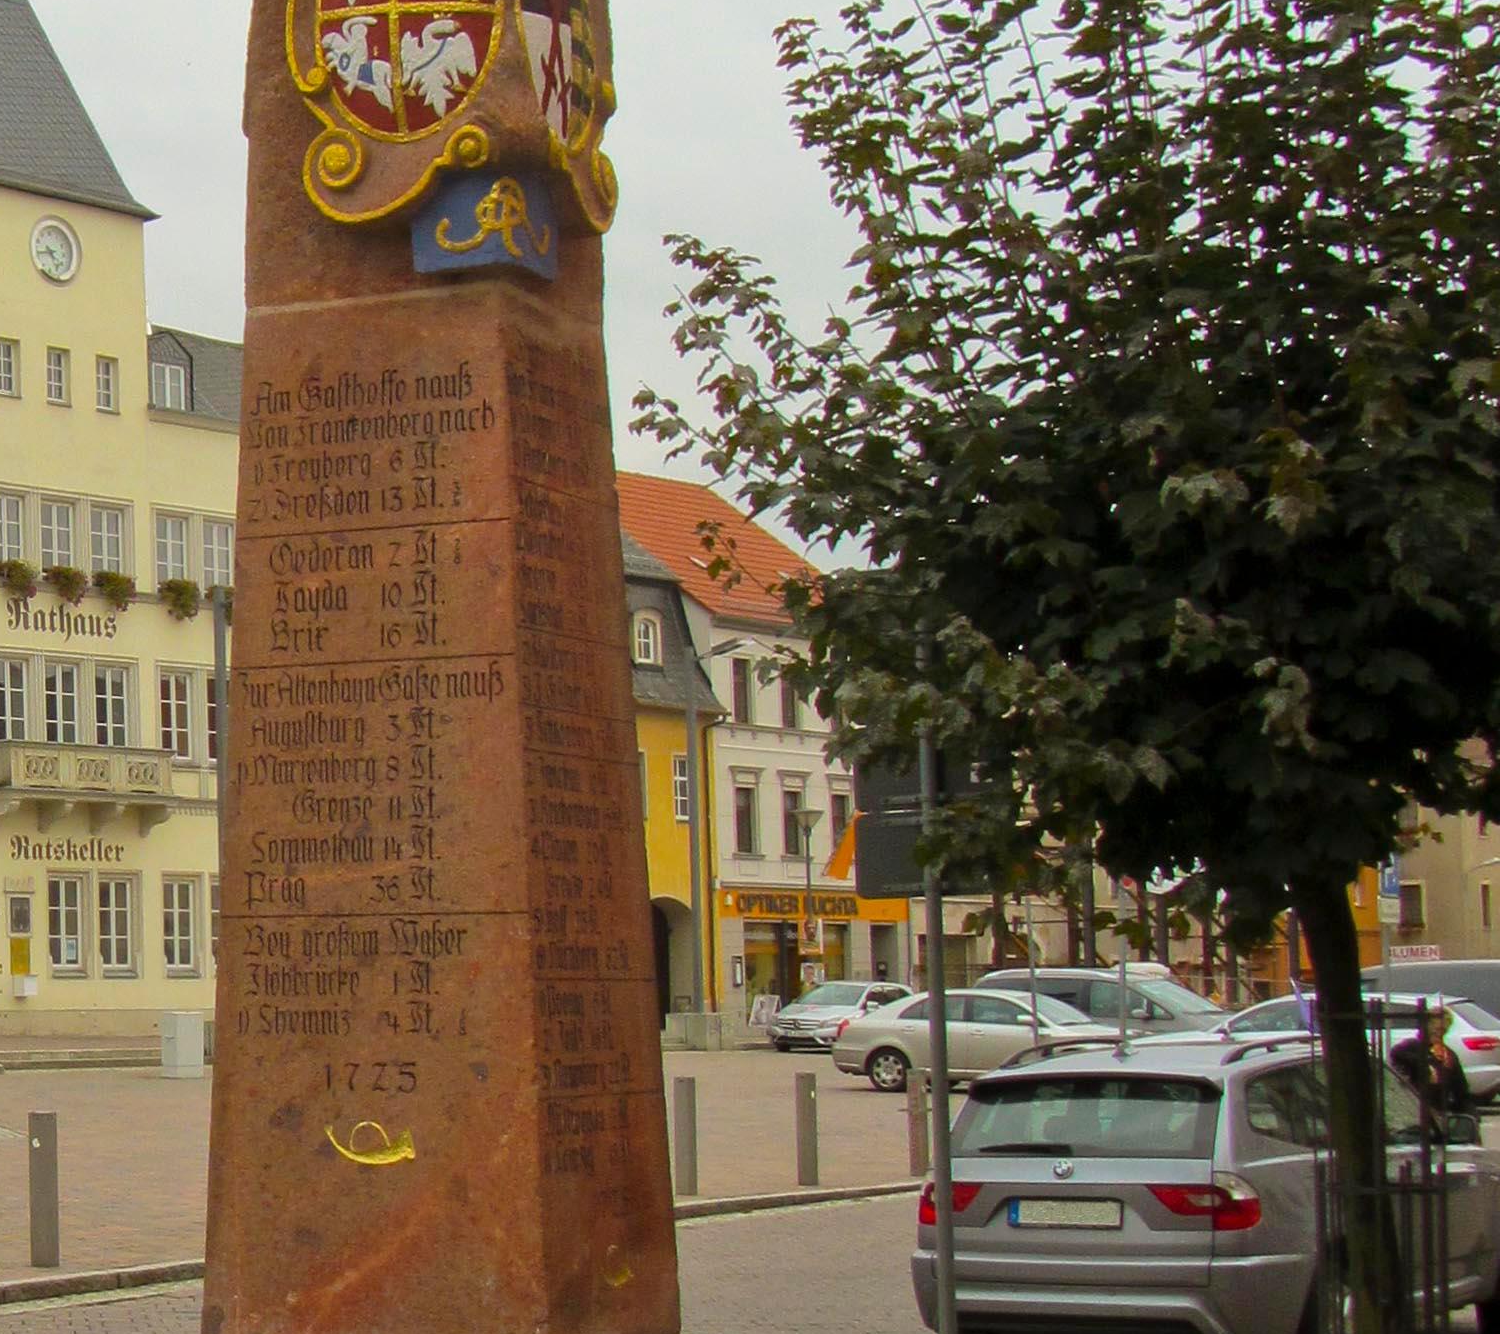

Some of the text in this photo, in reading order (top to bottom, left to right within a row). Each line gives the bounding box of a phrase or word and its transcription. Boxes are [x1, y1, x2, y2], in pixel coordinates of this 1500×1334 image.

[251, 381, 291, 415] Am
[439, 399, 495, 433] nach
[390, 450, 403, 473] 6
[381, 486, 404, 512] 13
[389, 542, 402, 567] 2
[381, 582, 402, 608] 10
[7, 597, 117, 643] Rathaus
[380, 623, 402, 648] 16
[386, 714, 400, 742] 3
[385, 757, 400, 782] 8
[10, 835, 124, 862] Ratskeller
[738, 892, 800, 914] OPTIKER
[1389, 946, 1438, 958] LUMEN
[323, 1062, 417, 1093] 1725
